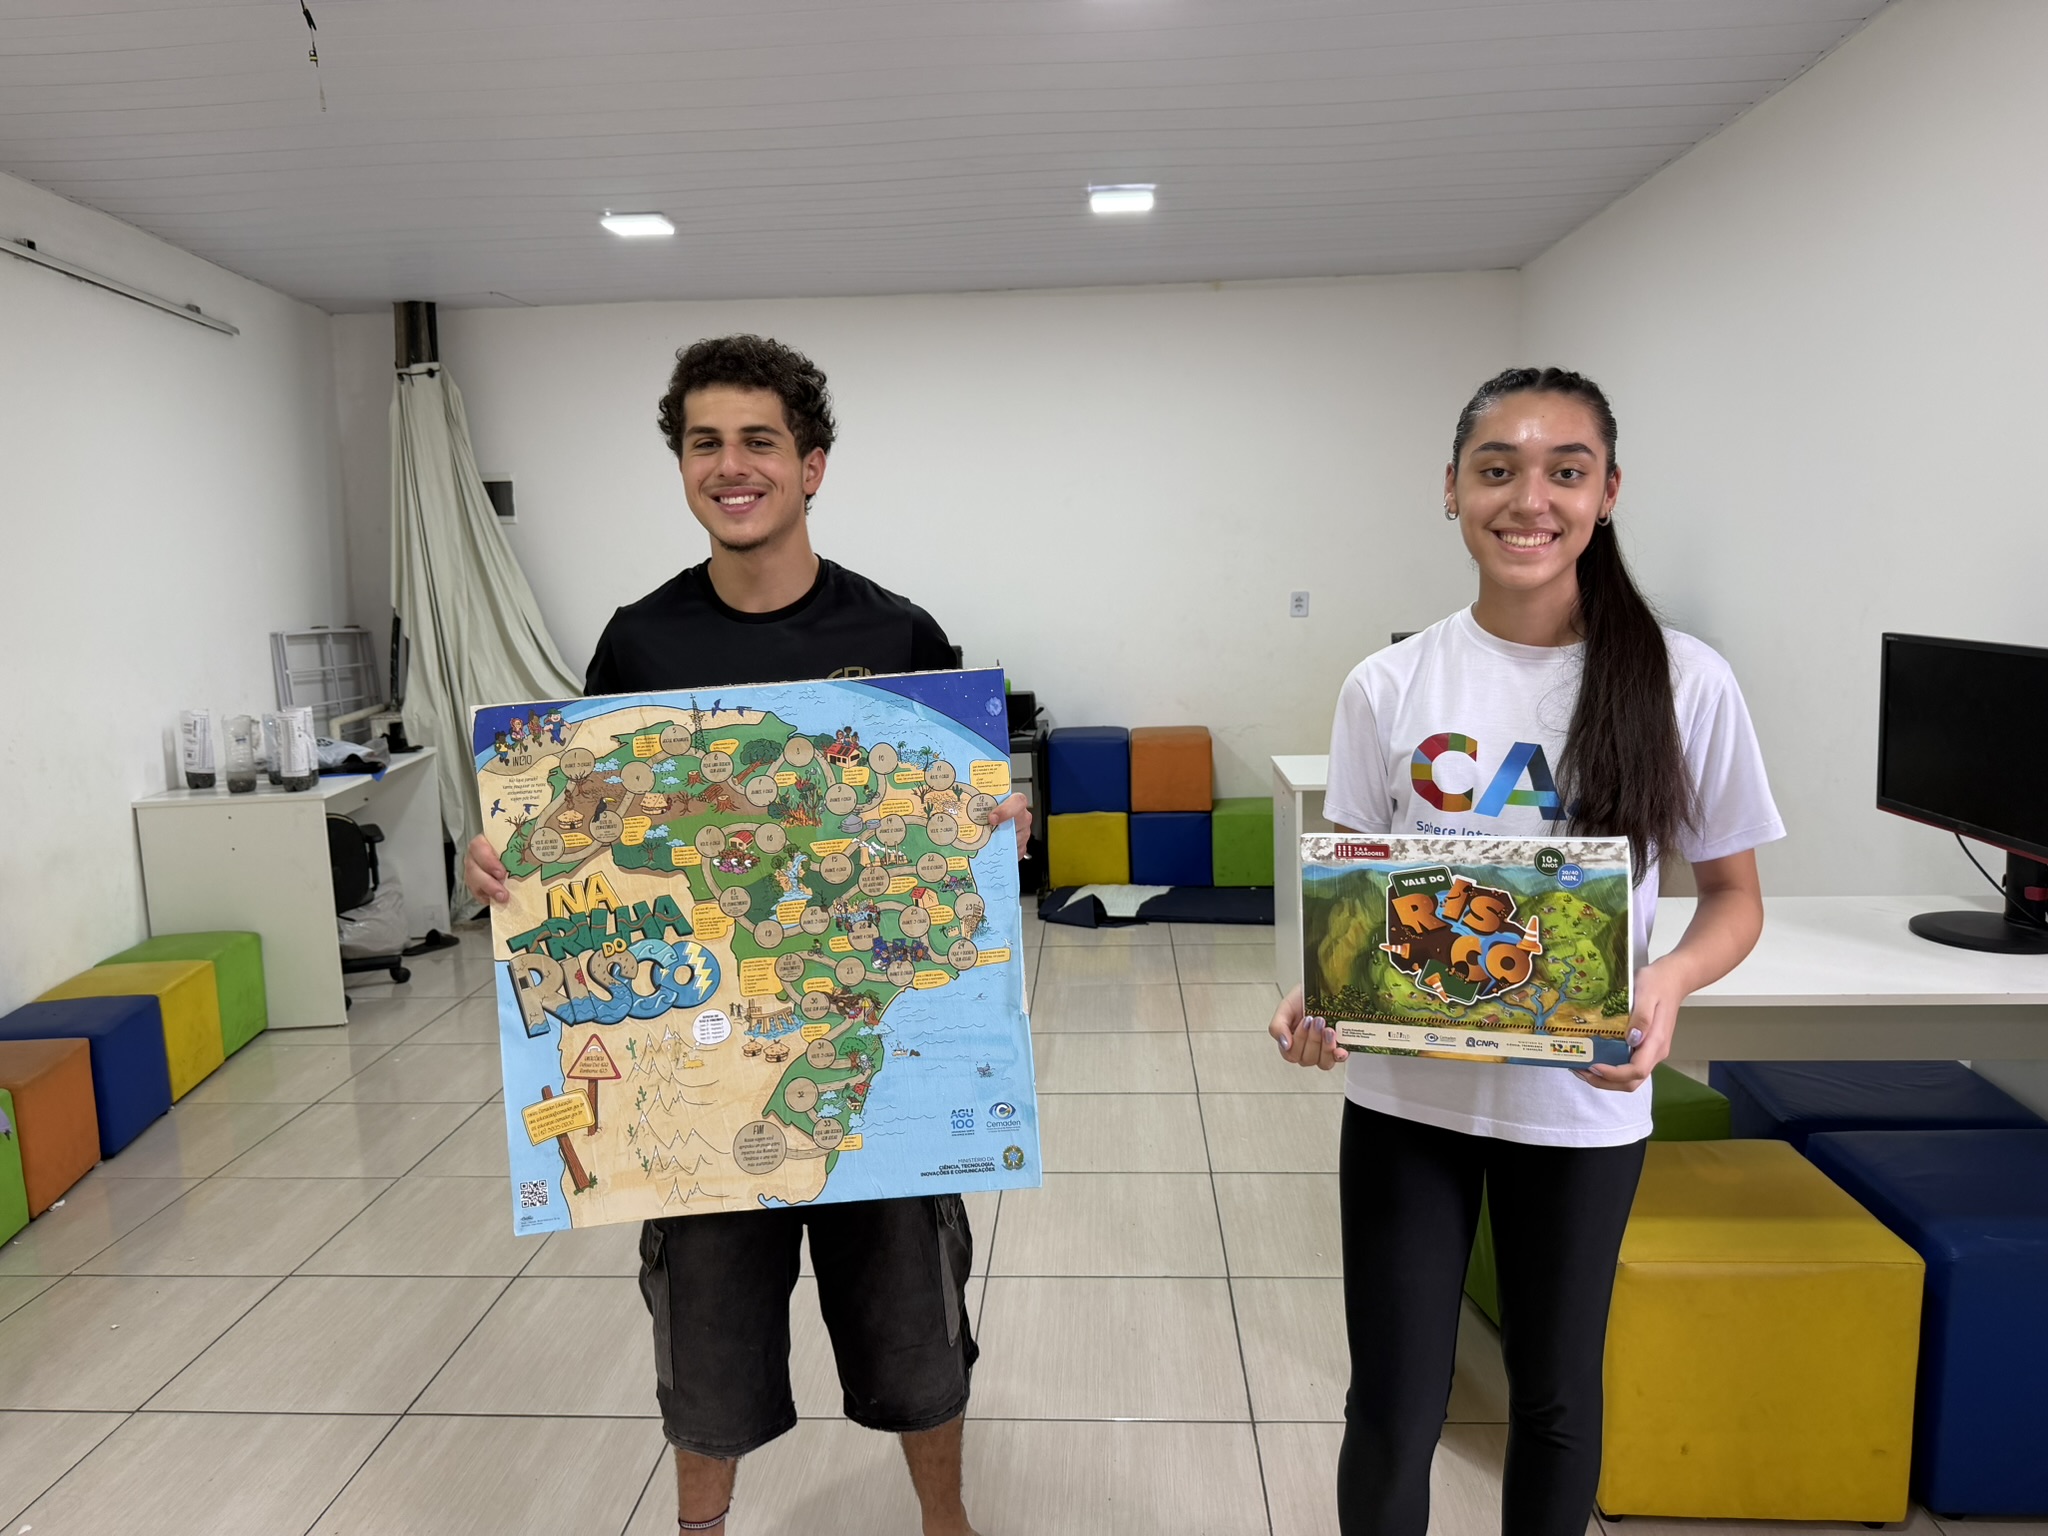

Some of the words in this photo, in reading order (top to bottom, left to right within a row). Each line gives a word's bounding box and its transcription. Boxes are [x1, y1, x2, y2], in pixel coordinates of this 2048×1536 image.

[1411, 732, 1568, 820] CA
[1416, 820, 1456, 835] Sphere
[1542, 855, 1559, 864] 10+
[1401, 877, 1426, 887] VALE
[1429, 875, 1445, 885] DO
[548, 871, 623, 918] NA
[506, 895, 694, 960] TRILHA
[602, 938, 627, 958] DO
[508, 941, 721, 1038] RISCO
[1476, 1039, 1499, 1049] CNPq
[950, 1108, 974, 1118] AGU
[753, 1124, 764, 1135] FIM
[950, 1119, 974, 1129] 100
